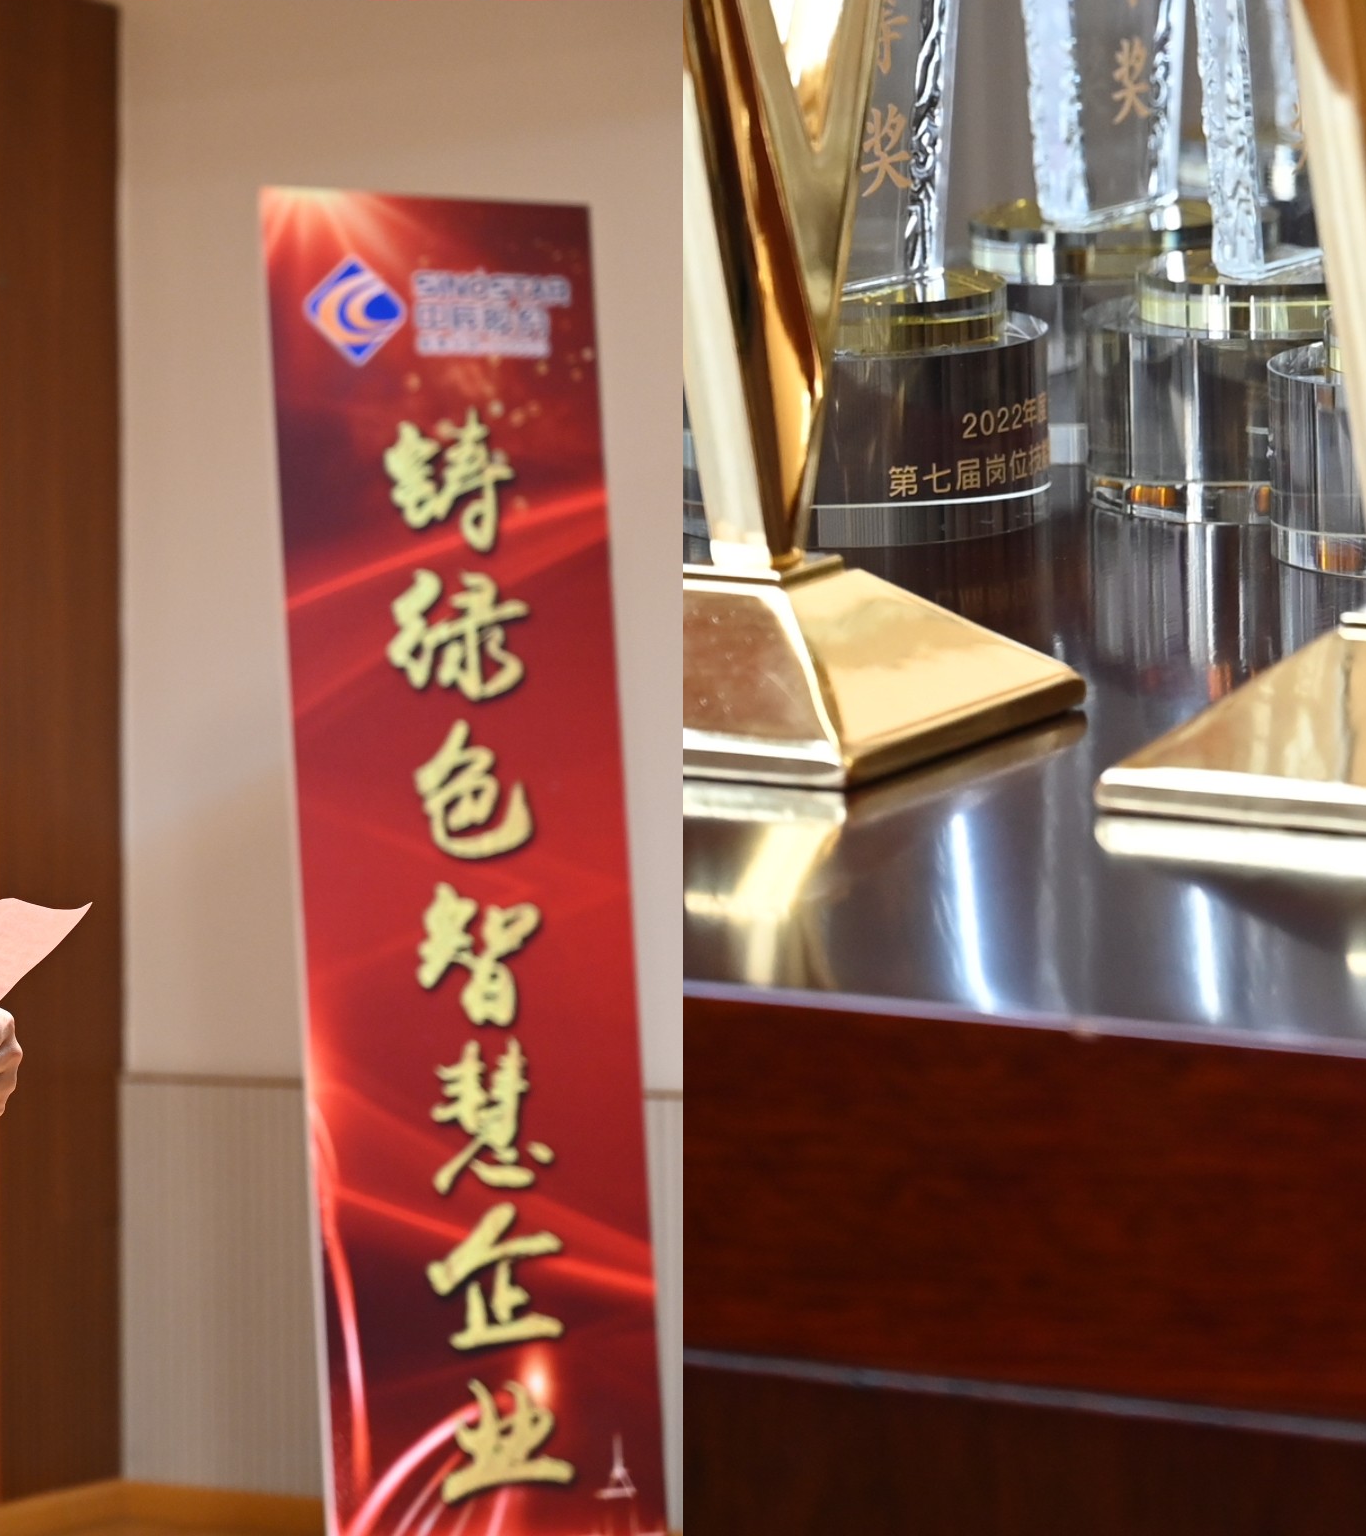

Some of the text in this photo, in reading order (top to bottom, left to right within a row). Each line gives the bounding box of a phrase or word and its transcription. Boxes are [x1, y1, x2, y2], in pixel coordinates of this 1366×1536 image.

[383, 405, 576, 1507] 铸绿色智慧企业
